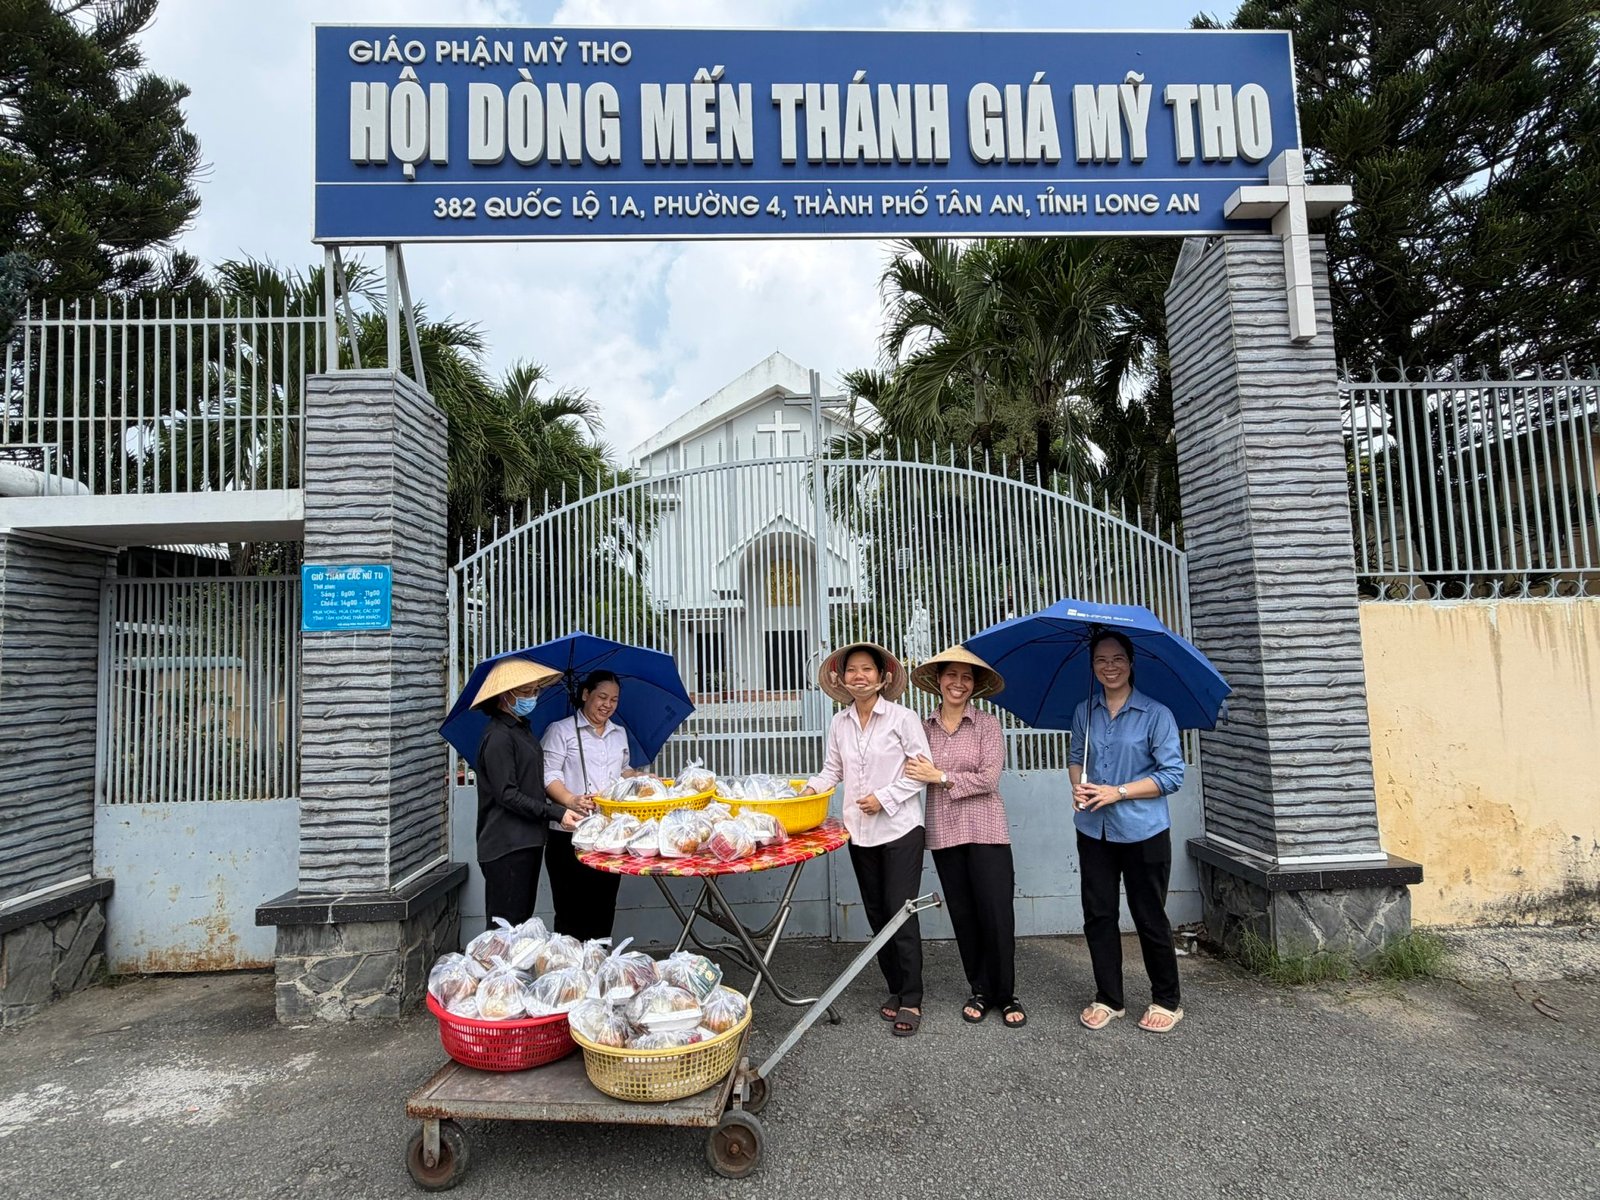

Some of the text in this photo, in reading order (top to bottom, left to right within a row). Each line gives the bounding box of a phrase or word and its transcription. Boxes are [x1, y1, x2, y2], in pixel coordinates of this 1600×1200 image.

[348, 34, 632, 67] GIÁO PHẬN MỸ THO
[349, 65, 1273, 179] HỘI DÒNG MẾN THÁNH GIÁ MỸ THO
[433, 185, 1201, 220] 382 QUỐC LỘ 1A, PHƯỜNG 4, THÀNH PHỐ TÂN AN, TỈNH LONG AN
[346, 570, 361, 580] CÁC
[374, 572, 383, 580] TU
[365, 589, 380, 598] 11g00
